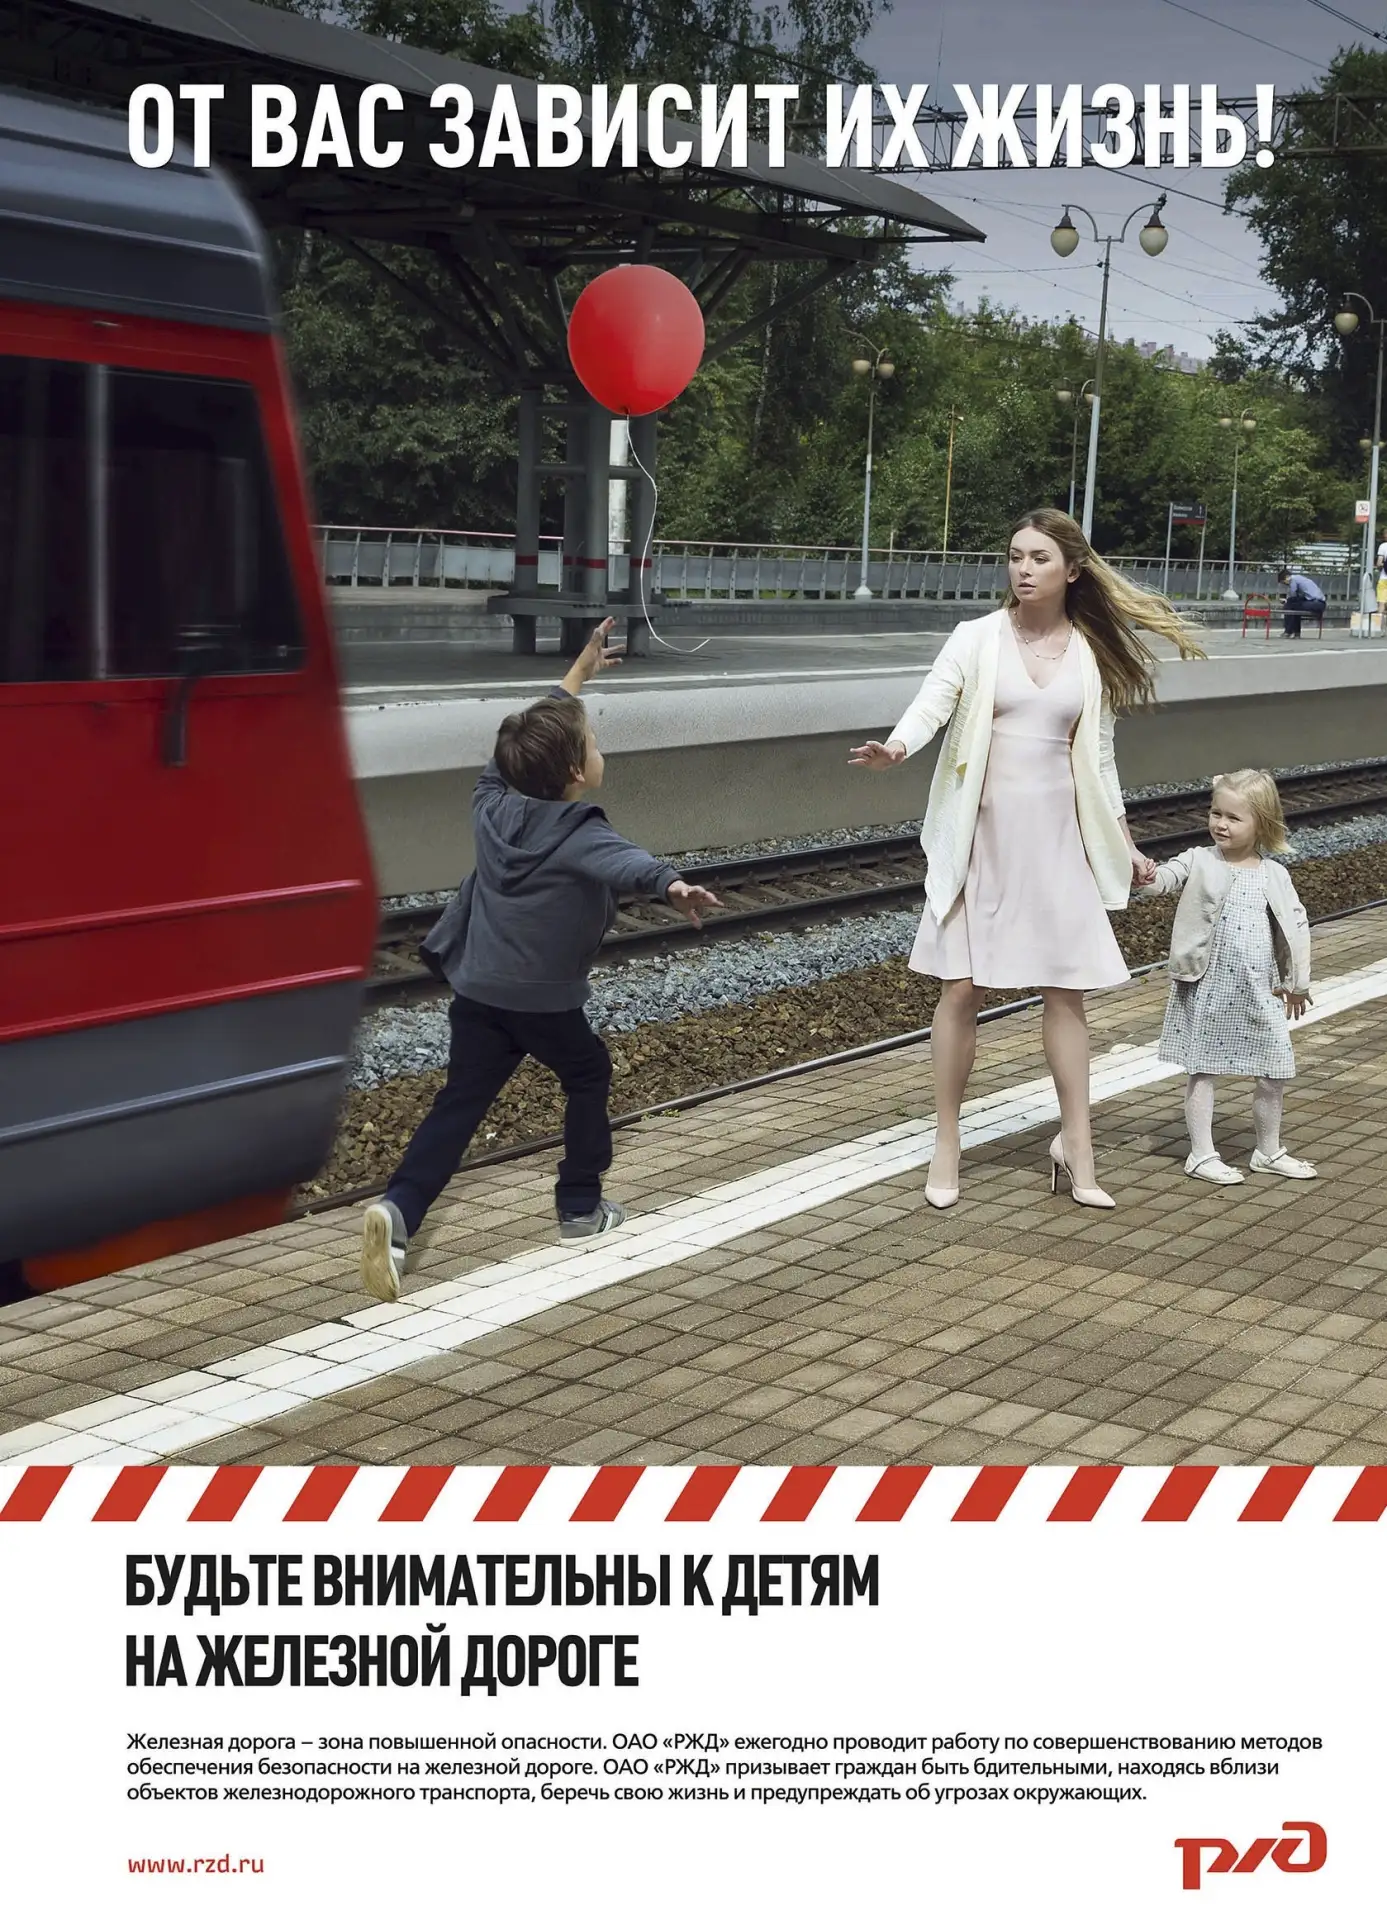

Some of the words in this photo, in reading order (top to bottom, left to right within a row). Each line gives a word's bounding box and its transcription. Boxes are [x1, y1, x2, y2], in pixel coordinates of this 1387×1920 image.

[128, 83, 225, 168] ОТ
[251, 83, 404, 168] ВАС
[429, 83, 799, 168] ЗАВИСИТ
[826, 83, 930, 168] ИХ
[951, 83, 1275, 168] ЖИЗНЬ!
[125, 1554, 303, 1617] БУДЬТЕ
[314, 1554, 671, 1607] ВНИМАТЕЛЬНЫ
[683, 1554, 715, 1607] К
[721, 1554, 879, 1617] ДЕТЯМ
[125, 1634, 189, 1688] НА
[195, 1622, 451, 1688] ЖЕЛЕЗНОЙ
[460, 1634, 640, 1697] ДОРОГЕ
[126, 1733, 224, 1750] Железная
[227, 1736, 296, 1754] дорога
[318, 1736, 364, 1750] зона
[369, 1731, 497, 1750] повышенной
[501, 1736, 607, 1750] опасности.
[612, 1732, 658, 1750] ОАО
[662, 1733, 730, 1753] «РЖД»
[734, 1736, 829, 1753] ежегодно
[833, 1736, 928, 1754] проводит
[932, 1731, 1000, 1755] работу
[1004, 1736, 1029, 1750] по
[1033, 1736, 1236, 1755] совершенствованию
[1241, 1736, 1323, 1753] методов
[126, 1757, 253, 1775] обеспечения
[257, 1757, 392, 1775] безопасности
[397, 1762, 420, 1775] на
[424, 1757, 521, 1775] железной
[524, 1762, 598, 1780] дороге.
[603, 1758, 649, 1775] ОАО
[653, 1758, 721, 1778] «РЖД»
[725, 1762, 831, 1780] призывает
[835, 1762, 917, 1780] граждан
[921, 1757, 970, 1775] быть
[973, 1757, 1113, 1778] бдительными,
[1118, 1762, 1206, 1778] находясь
[1210, 1756, 1279, 1775] вблизи
[126, 1782, 219, 1801] объектов
[222, 1787, 416, 1805] железнодорожного
[419, 1787, 536, 1805] транспорта,
[540, 1782, 610, 1805] беречь
[614, 1787, 664, 1801] свою
[667, 1787, 730, 1801] жизнь
[733, 1787, 746, 1800] и
[751, 1787, 902, 1805] предупреждать
[905, 1782, 931, 1801] об
[934, 1787, 1010, 1805] угрозах
[1013, 1787, 1147, 1805] окружающих.
[128, 1853, 264, 1874] www.rzd.ru
